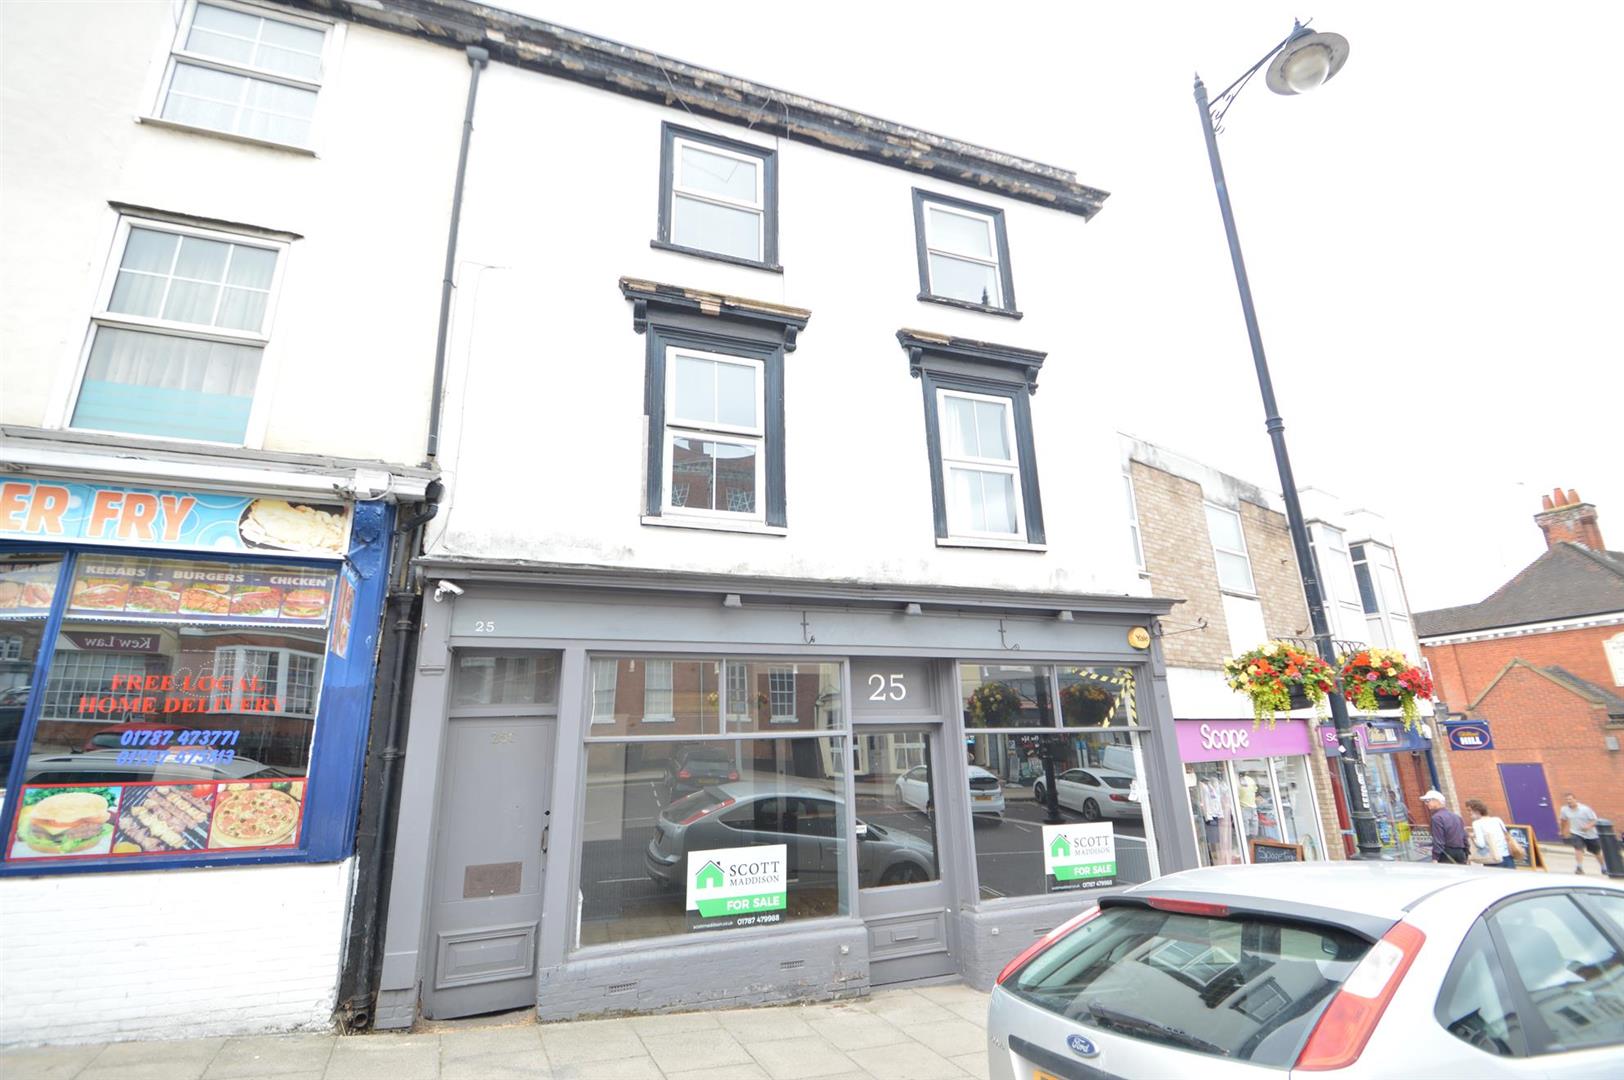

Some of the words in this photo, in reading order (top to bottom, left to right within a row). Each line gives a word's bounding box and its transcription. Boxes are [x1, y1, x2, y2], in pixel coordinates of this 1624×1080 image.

[87, 490, 197, 541] FRY
[86, 565, 146, 577] KEBABS
[173, 570, 245, 583] BURGERS
[270, 576, 326, 587] CHICKEN
[475, 621, 495, 632] 25
[111, 675, 175, 691] FREE
[182, 675, 265, 692] LOCAL
[868, 673, 906, 701] 25
[78, 697, 157, 713] HOME
[163, 697, 285, 713] DELIVERY
[120, 730, 174, 746] 01787
[177, 730, 240, 746] 473771
[1200, 723, 1249, 754] Scope
[1073, 835, 1109, 848] SCOTT
[729, 861, 780, 877] SCOTT
[1073, 866, 1091, 876] FOR
[1092, 864, 1112, 873] SALE
[729, 875, 779, 886] MADDISON
[726, 900, 750, 911] FOR
[753, 896, 780, 908] SALE
[1071, 1037, 1091, 1054] Ford
